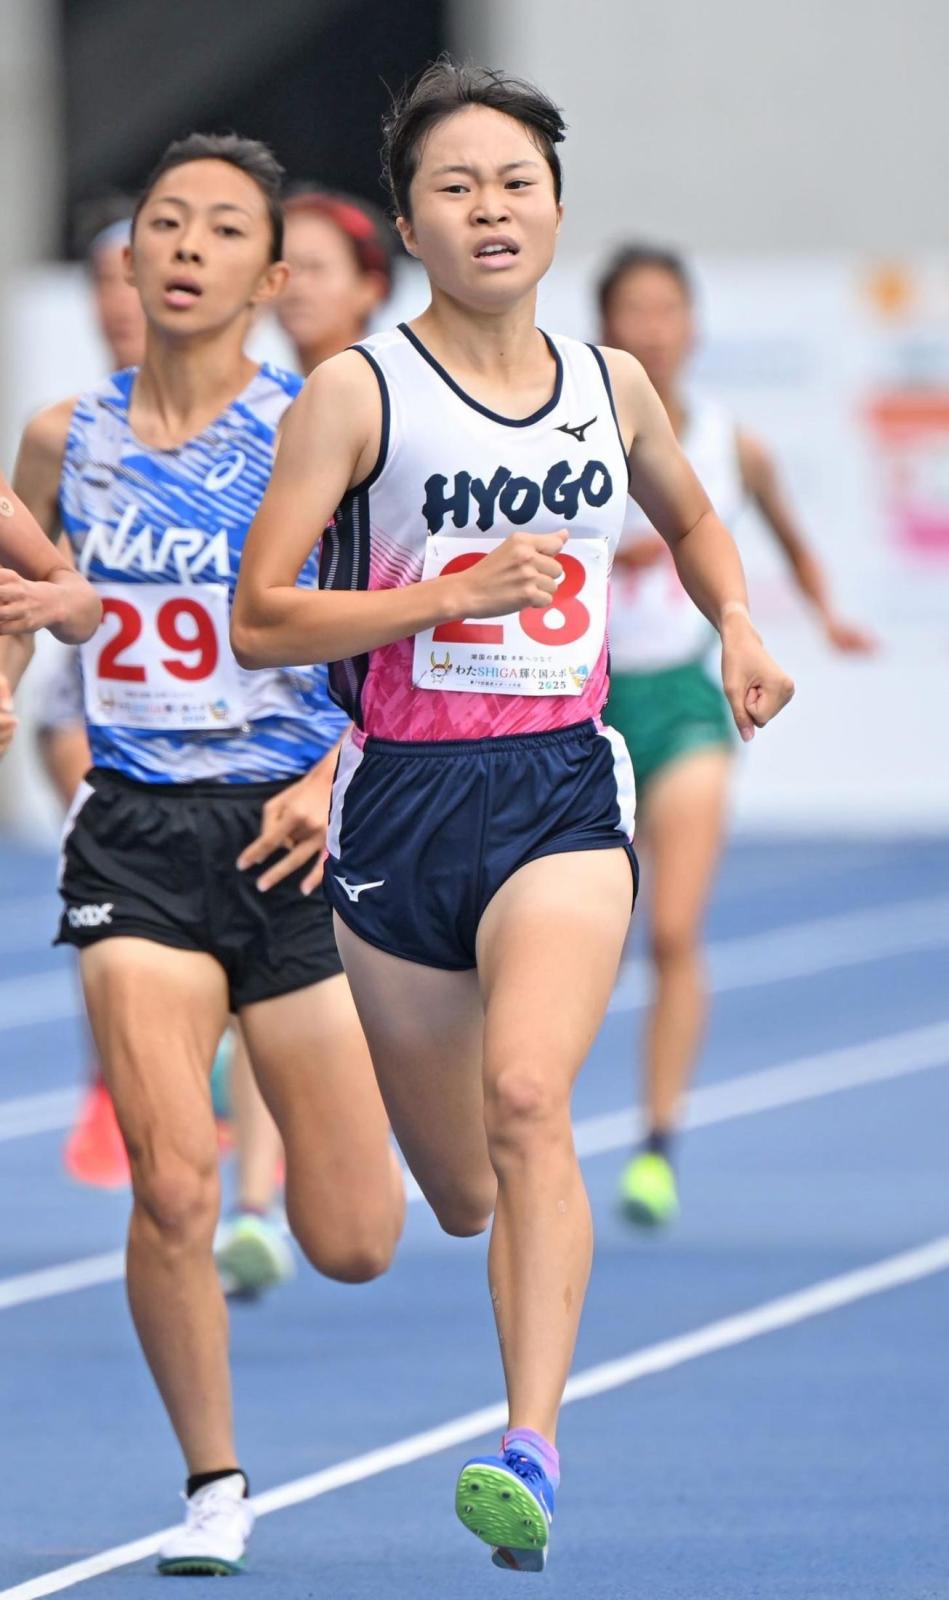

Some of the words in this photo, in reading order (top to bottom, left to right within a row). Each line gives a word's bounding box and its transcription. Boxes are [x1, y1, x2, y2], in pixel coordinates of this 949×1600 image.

[422, 460, 613, 535] HYOGO
[79, 504, 231, 585] NARA
[96, 596, 219, 683] 29
[538, 681, 567, 690] 2025
